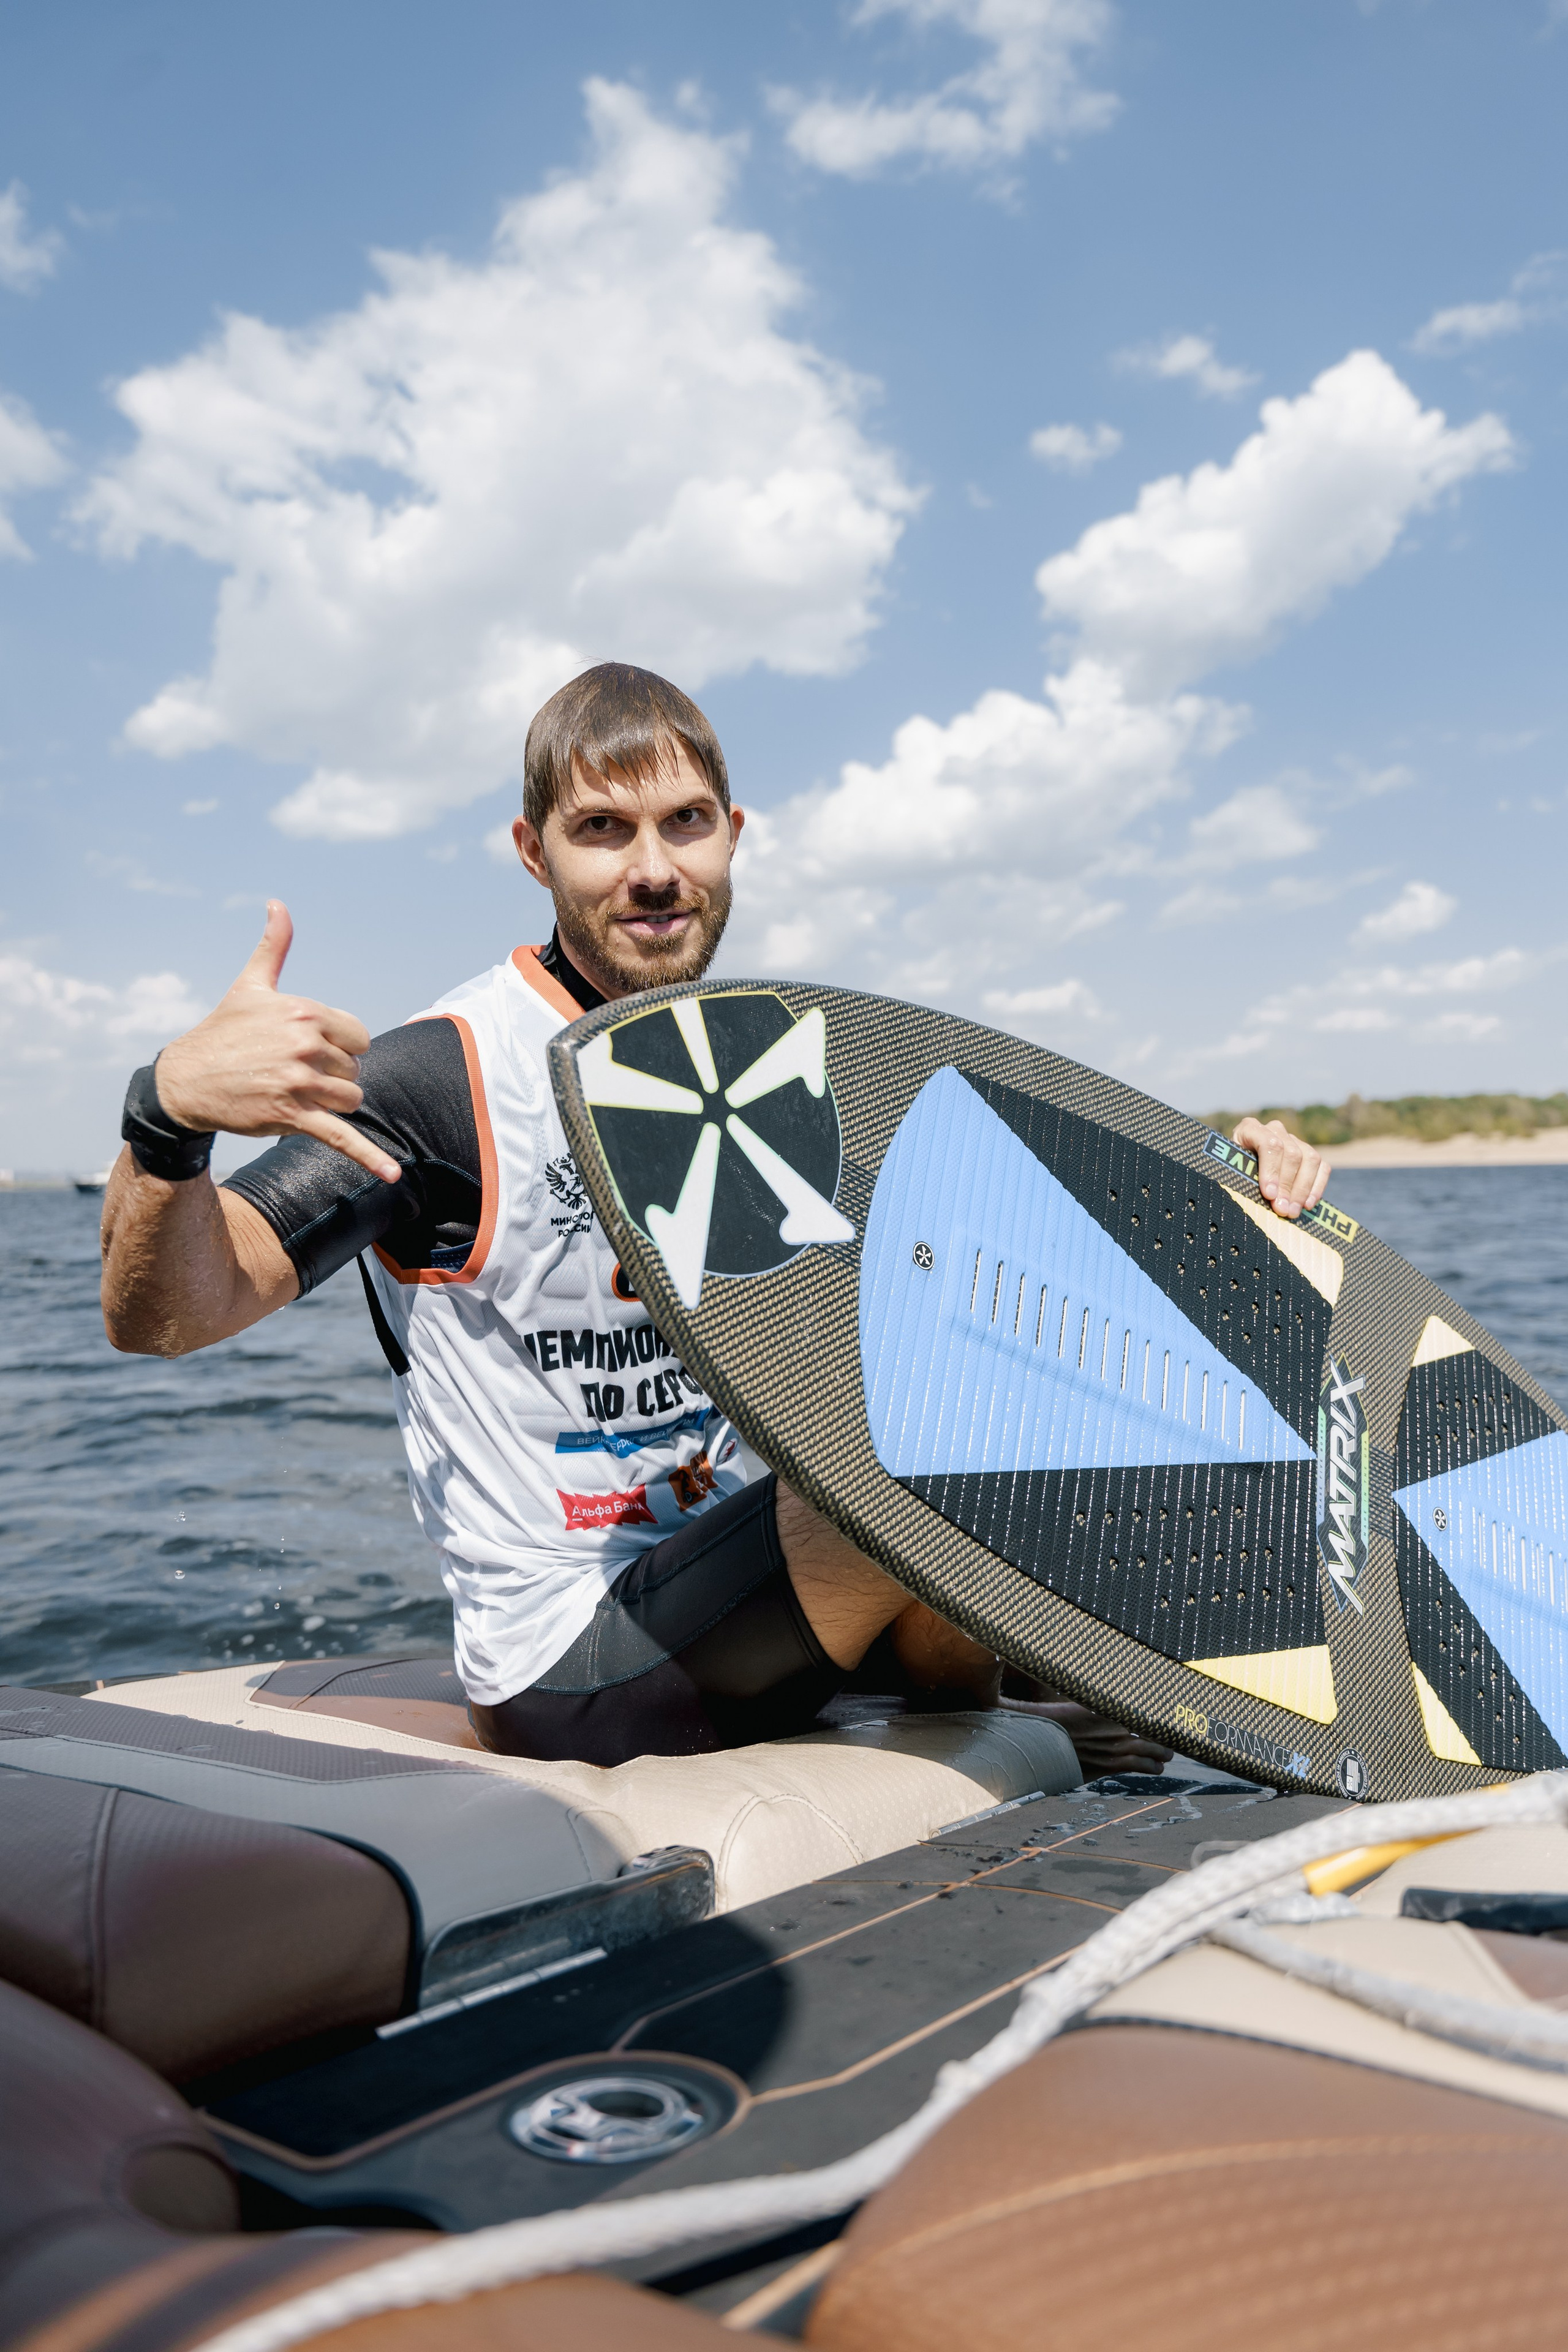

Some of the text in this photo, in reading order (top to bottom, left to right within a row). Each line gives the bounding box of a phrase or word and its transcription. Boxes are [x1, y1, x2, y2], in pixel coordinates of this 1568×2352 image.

[1211, 1139, 1259, 1182] IVE
[558, 1223, 591, 1238] РОСИИ
[524, 1324, 679, 1373] ЕМПИОН
[579, 1381, 624, 1423] ПО
[1327, 1352, 1365, 1618] MATRIX
[1363, 1491, 1367, 1502] IN
[571, 1504, 612, 1520] Альфа
[1175, 1704, 1291, 1769] PROFORMANCE
[1338, 1750, 1351, 1765] AMERICA
[1336, 1771, 1348, 1798] HANDMADE
